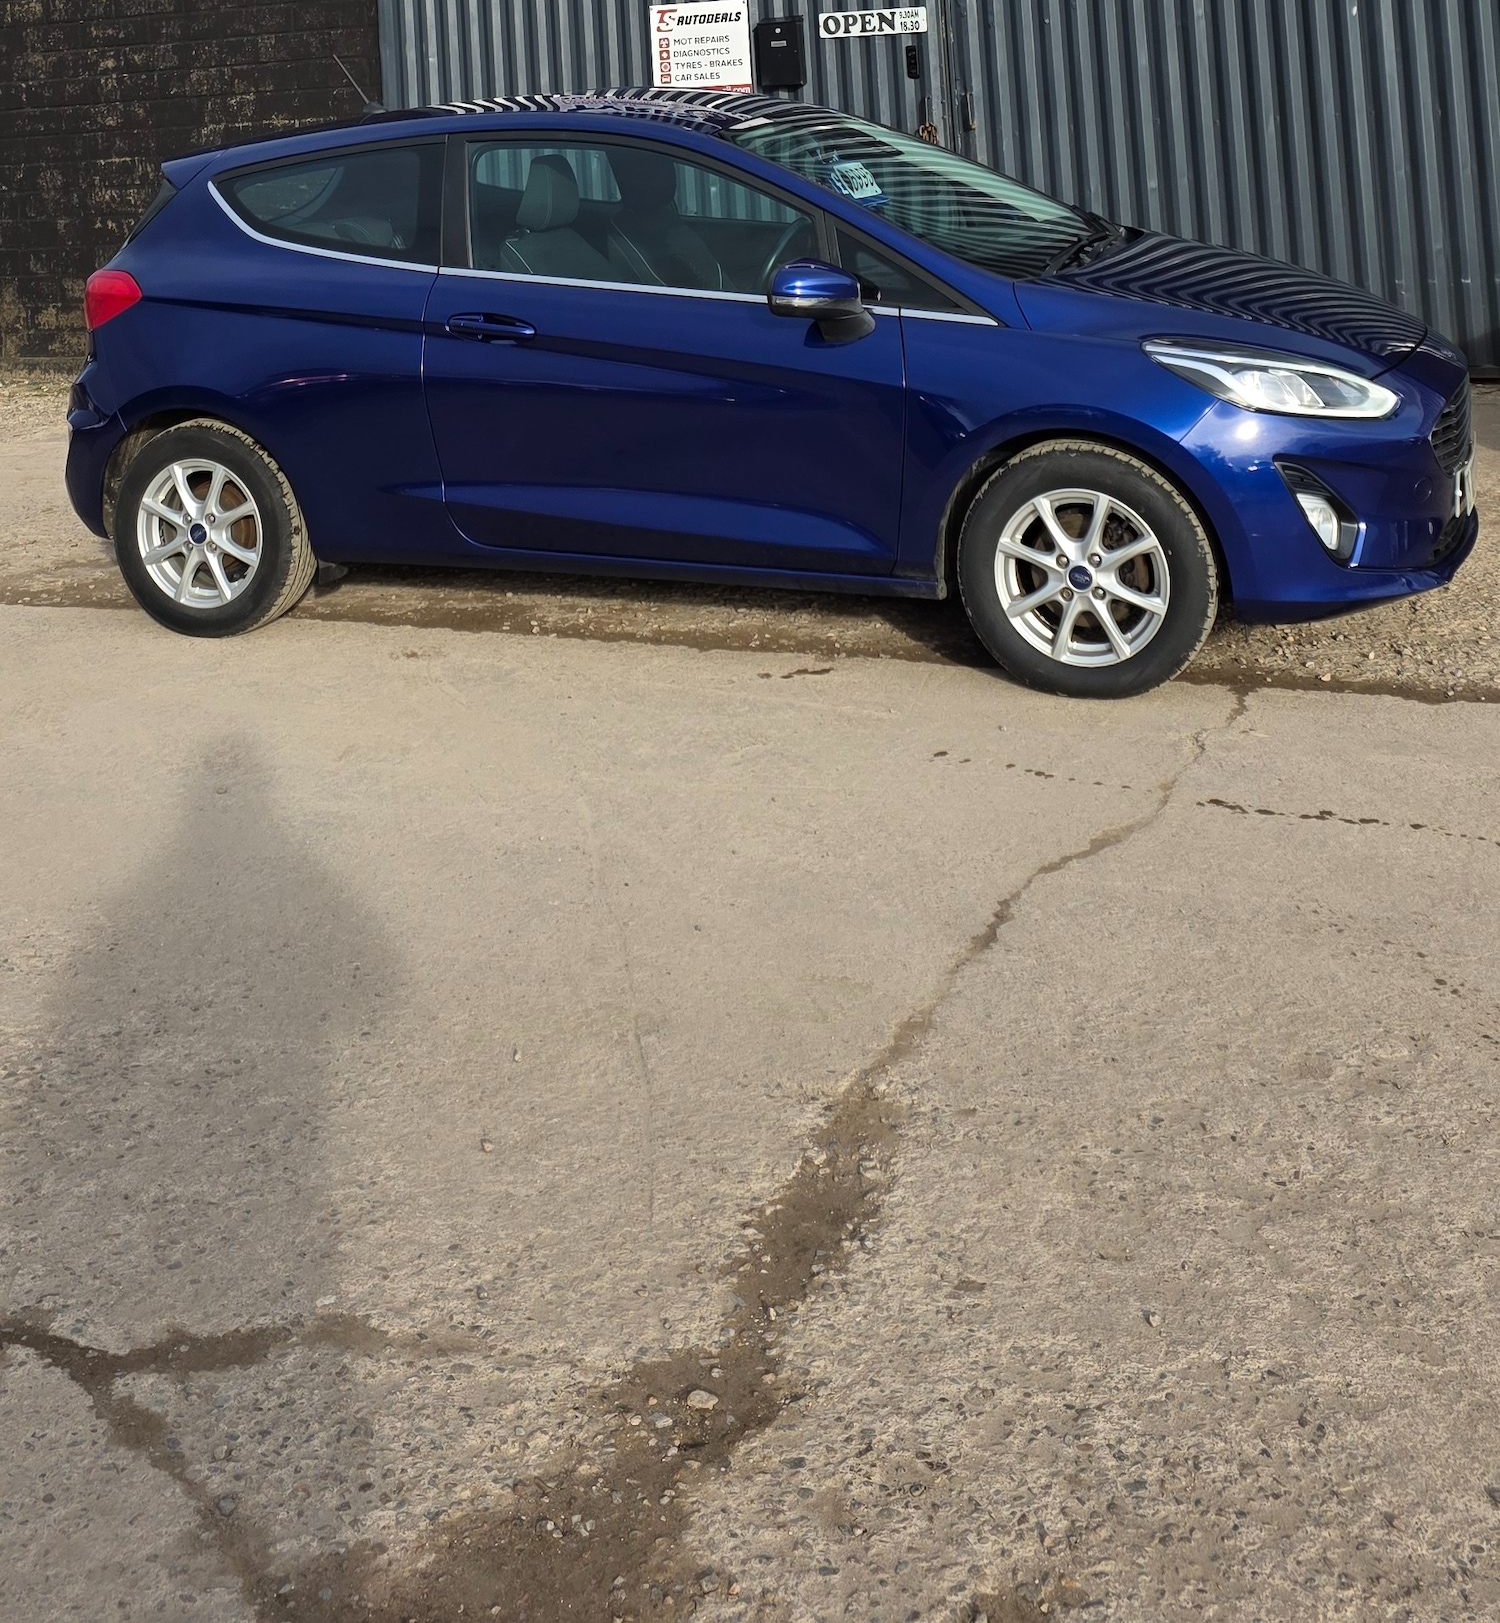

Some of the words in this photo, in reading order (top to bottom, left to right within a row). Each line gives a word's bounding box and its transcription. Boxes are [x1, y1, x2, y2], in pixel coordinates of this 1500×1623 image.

[677, 11, 742, 26] AUTODEALS
[823, 11, 897, 35] OPEN
[673, 37, 692, 46] MOT
[694, 35, 730, 45] REPAIRS
[673, 47, 731, 58] DIAGNOSTICS
[675, 61, 702, 70] TYRES
[709, 58, 743, 68] BRAKES
[674, 73, 692, 82] CAR
[694, 72, 721, 81] SALES
